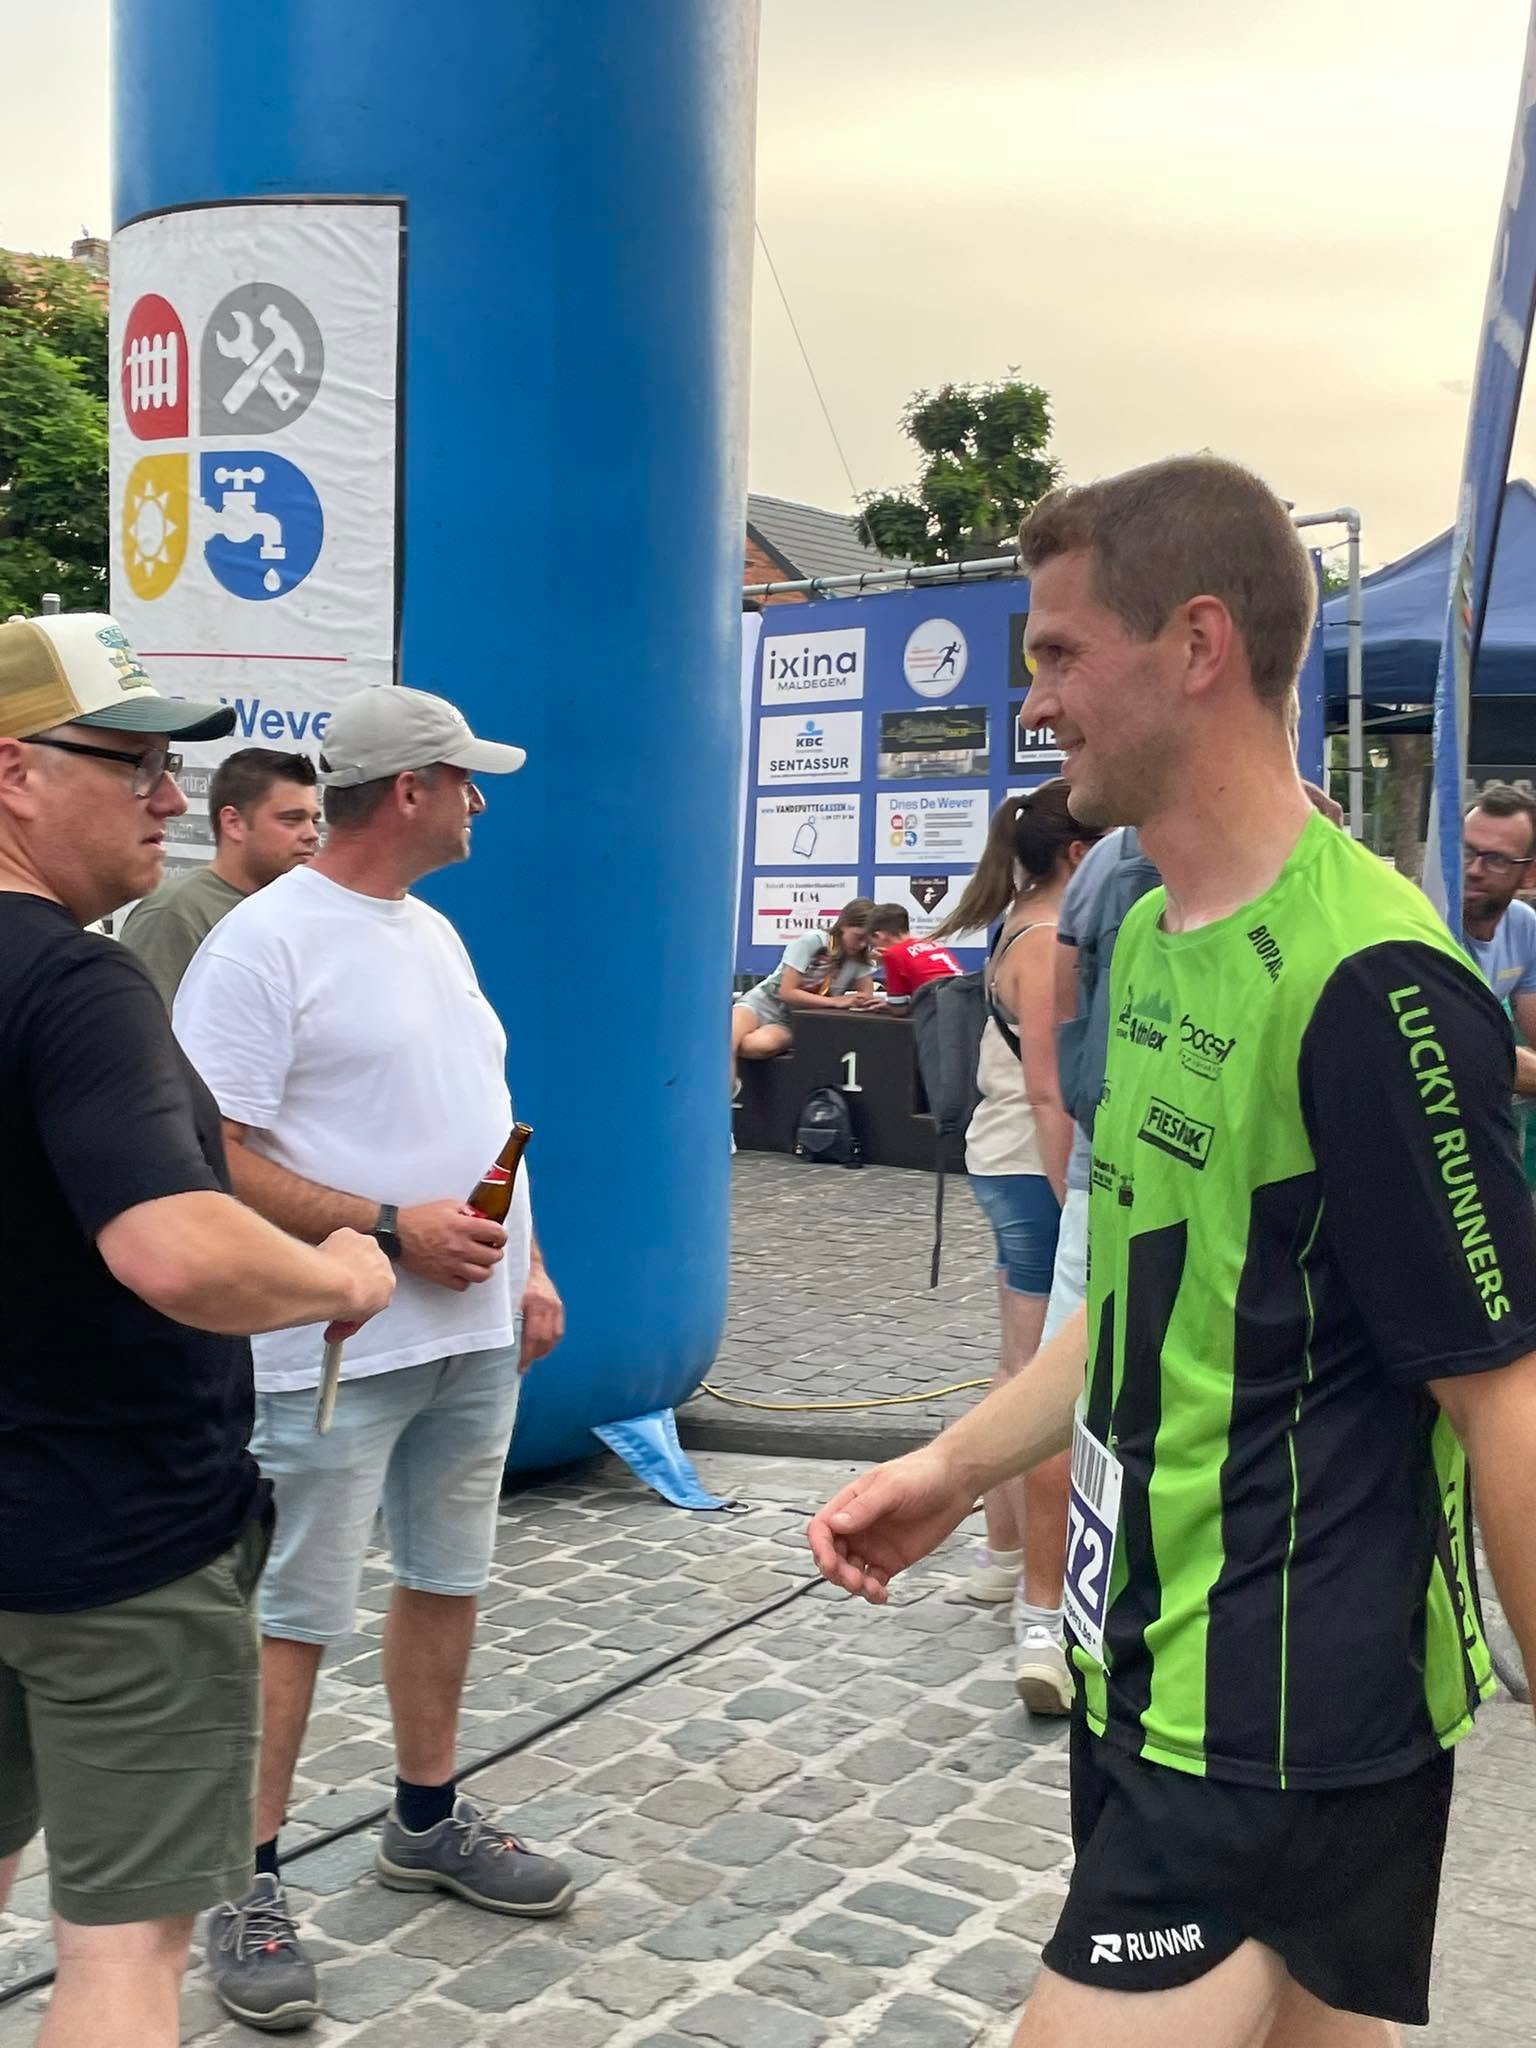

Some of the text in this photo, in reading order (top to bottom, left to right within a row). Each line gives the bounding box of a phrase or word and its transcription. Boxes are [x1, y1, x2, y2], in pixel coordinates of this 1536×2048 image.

[770, 647, 857, 679] ixina
[777, 677, 847, 691] MALDEGEM
[796, 737, 824, 748] KBC
[769, 757, 849, 772] SENTASSUR
[920, 798, 936, 809] De
[937, 797, 975, 809] Wever
[841, 1051, 863, 1092] 1
[1388, 985, 1511, 1322] LUCKY RUNNERS
[1126, 1923, 1205, 1962] RUNNR
